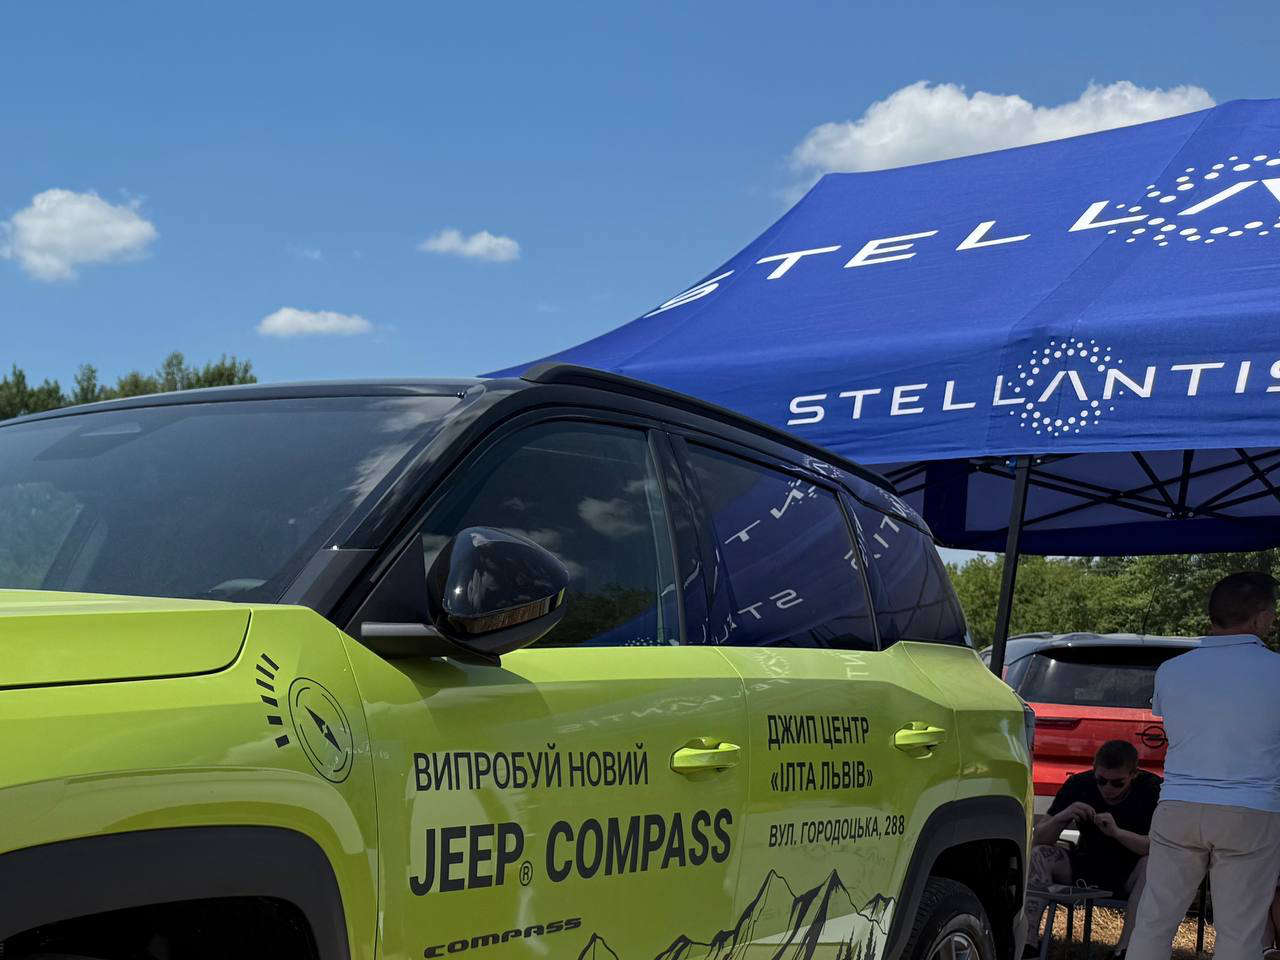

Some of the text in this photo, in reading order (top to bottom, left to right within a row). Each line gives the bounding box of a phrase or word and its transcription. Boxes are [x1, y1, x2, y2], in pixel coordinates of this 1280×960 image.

[767, 714, 870, 750] ДЖИП ЦЕНТР
[413, 742, 562, 792] ВИПРОБУЙ
[568, 742, 649, 788] НОВИЙ
[819, 760, 874, 791] ЛЬВІВ»
[545, 808, 734, 883] COMPASS
[768, 814, 906, 848] ВУЛ. ГОРОДОЦЬКА, 288
